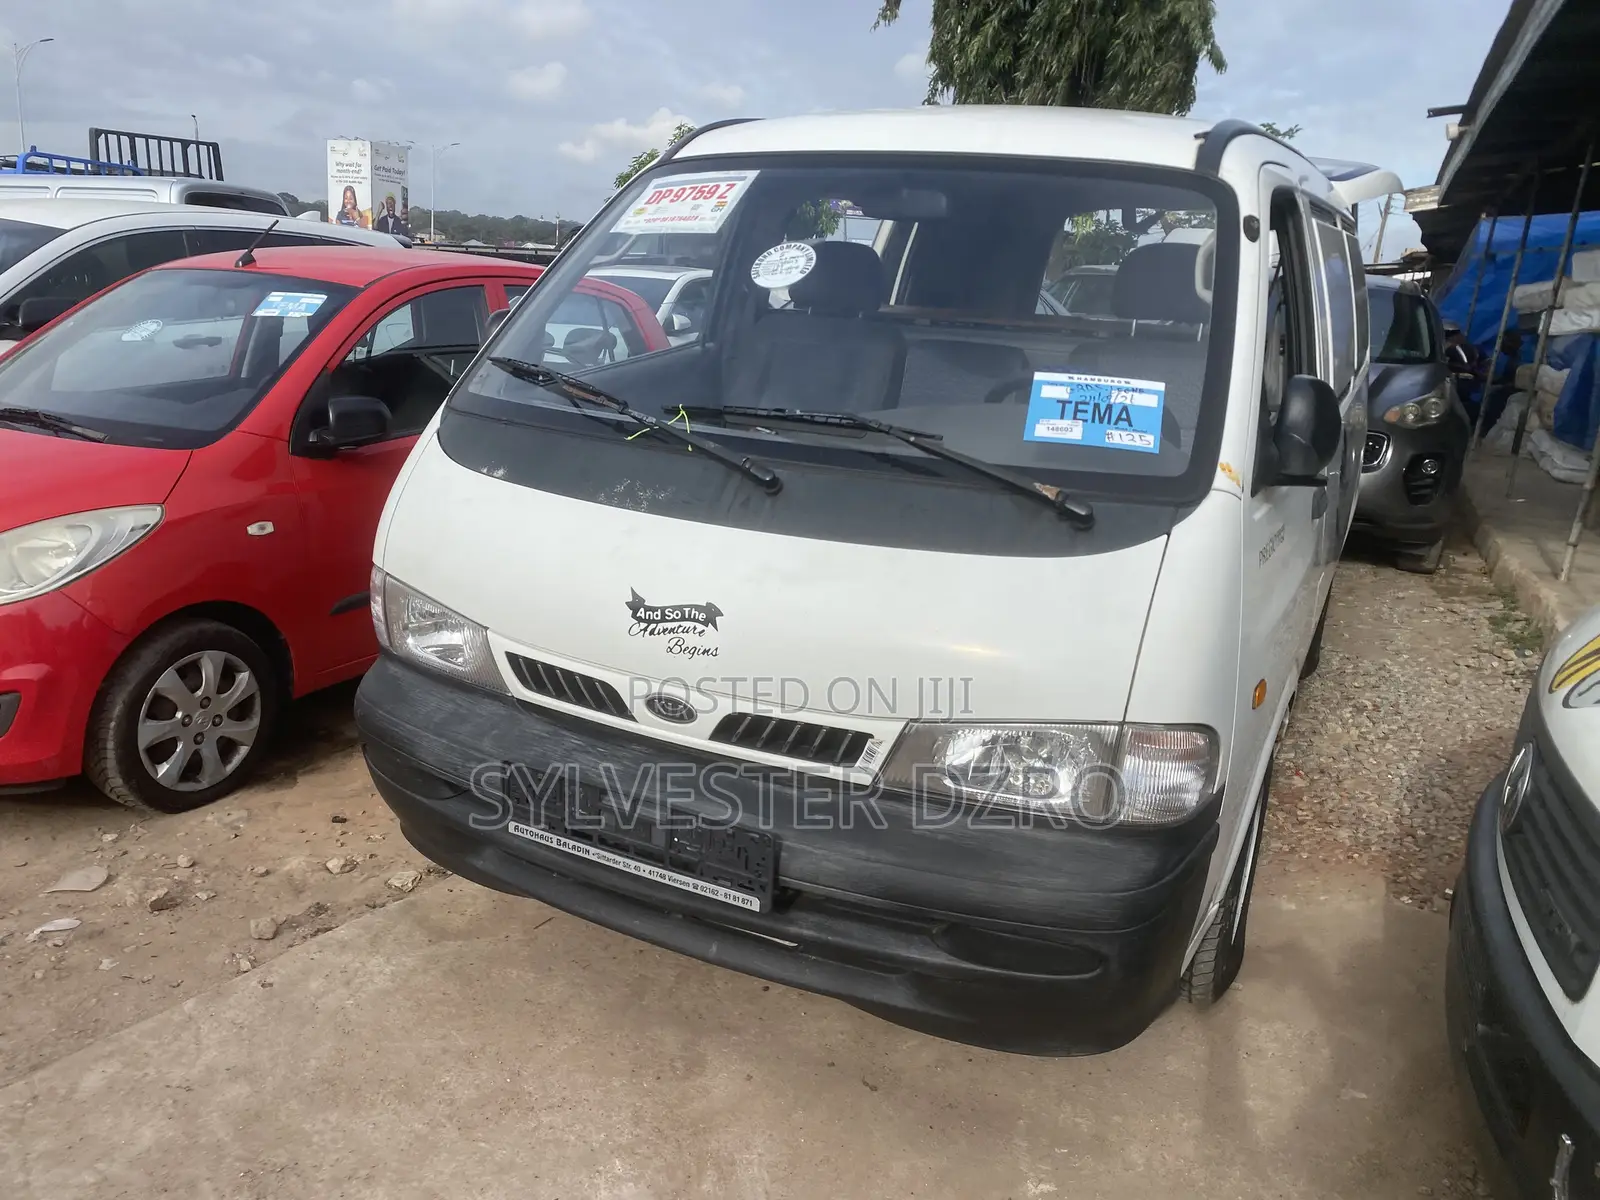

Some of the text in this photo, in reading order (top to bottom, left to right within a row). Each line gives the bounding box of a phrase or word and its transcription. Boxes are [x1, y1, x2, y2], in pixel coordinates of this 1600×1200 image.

[382, 166, 392, 174] Paid
[392, 167, 406, 176] Today!
[716, 183, 737, 200] Z
[773, 243, 809, 255] COMPANY
[799, 251, 815, 275] LIMITED
[1076, 376, 1122, 384] HAMBURG
[1056, 399, 1133, 428] TEMA
[1105, 431, 1152, 446] #125
[636, 607, 706, 621] And So The
[628, 621, 706, 638] Adventure
[666, 636, 719, 660] Begins
[654, 699, 689, 720] KIA
[622, 861, 632, 871] Str.
[633, 864, 641, 873] 40
[647, 869, 667, 881] 41748
[667, 874, 690, 888] Viersen
[699, 884, 719, 897] 02162
[724, 892, 731, 900] 81
[732, 894, 740, 902] 81
[740, 897, 753, 907] 871
